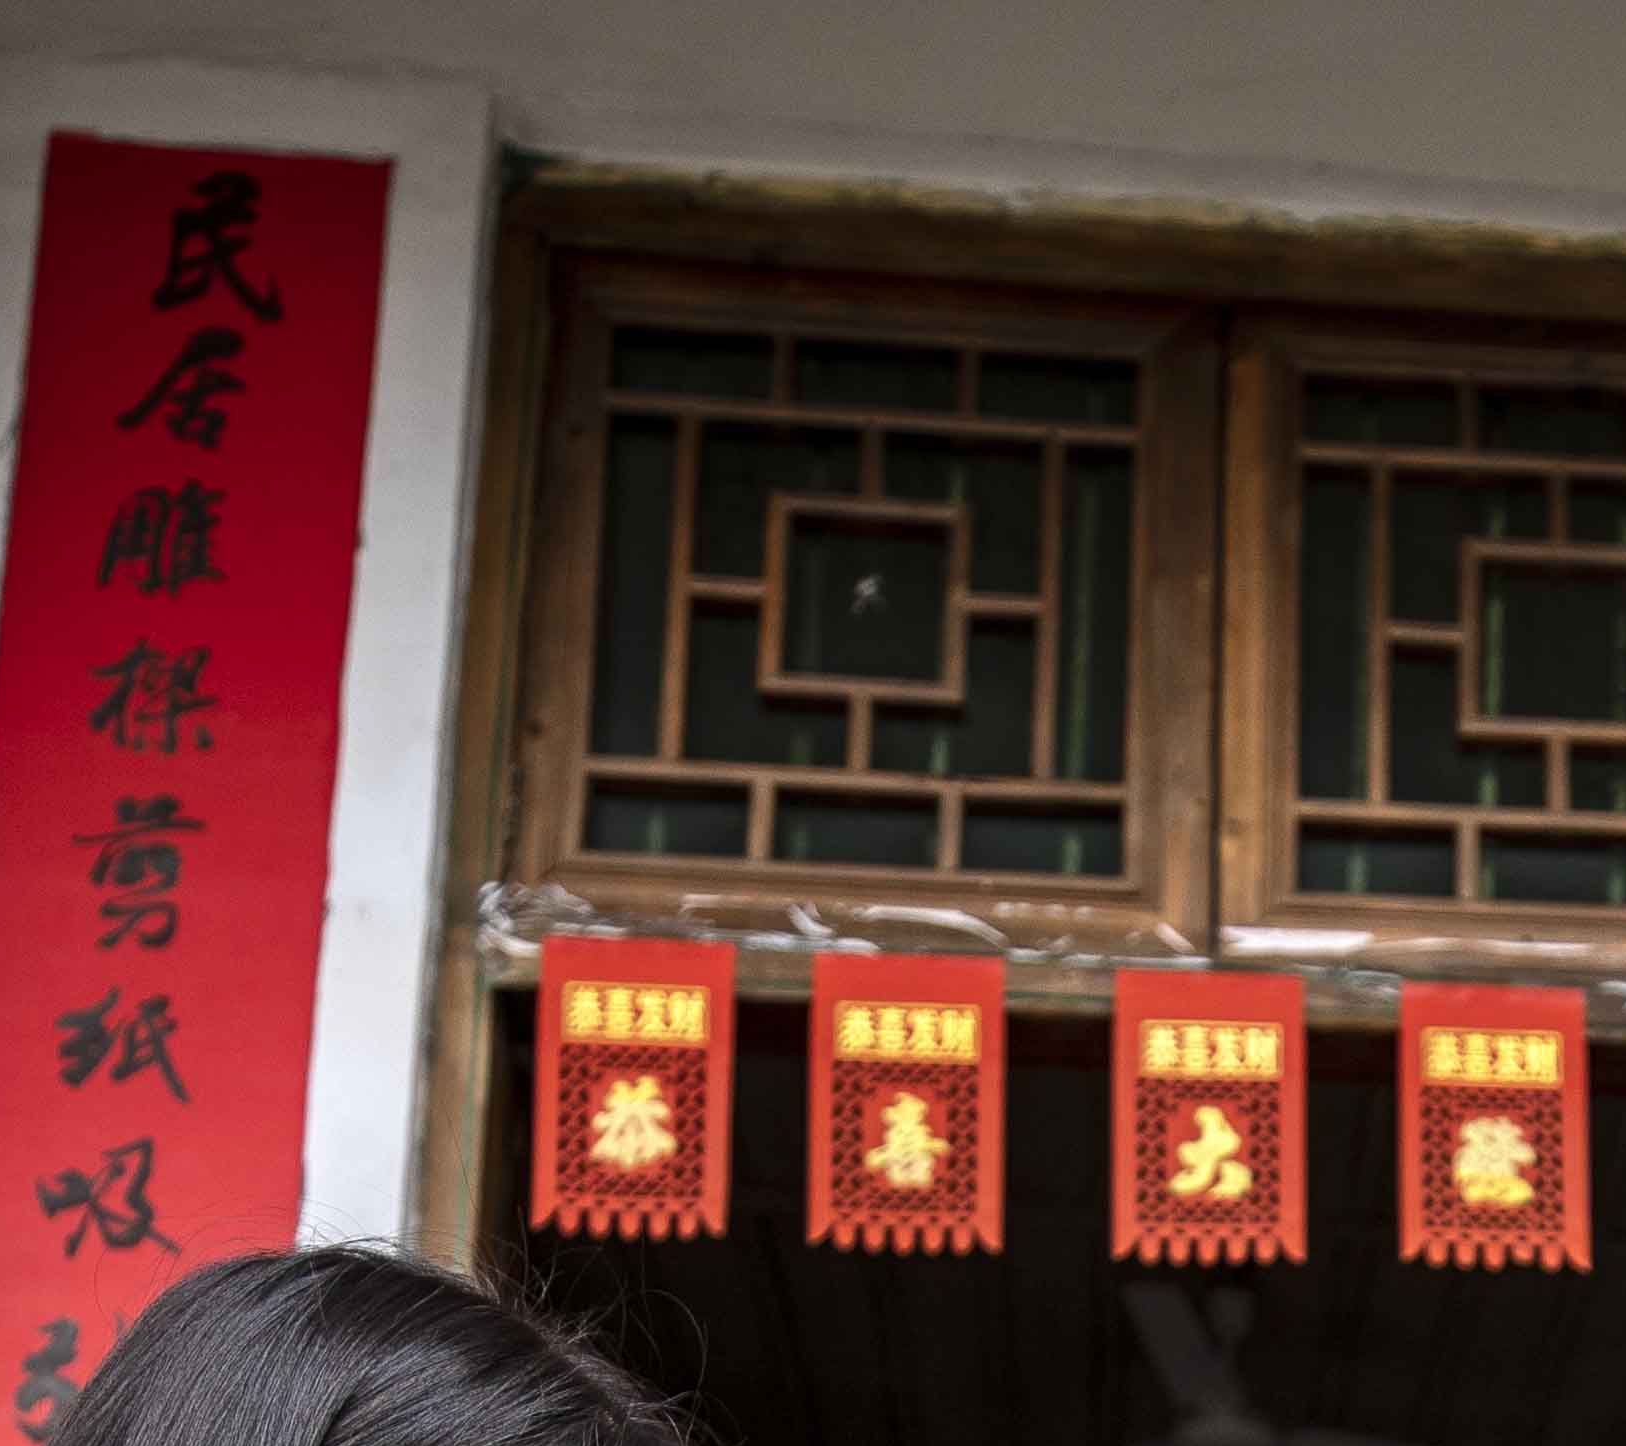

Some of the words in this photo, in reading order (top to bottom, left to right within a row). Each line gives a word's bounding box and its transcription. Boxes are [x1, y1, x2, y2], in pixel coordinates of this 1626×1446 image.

[590, 1075, 678, 1168] 恭
[864, 1092, 949, 1190] 喜
[1169, 1105, 1254, 1200] 大
